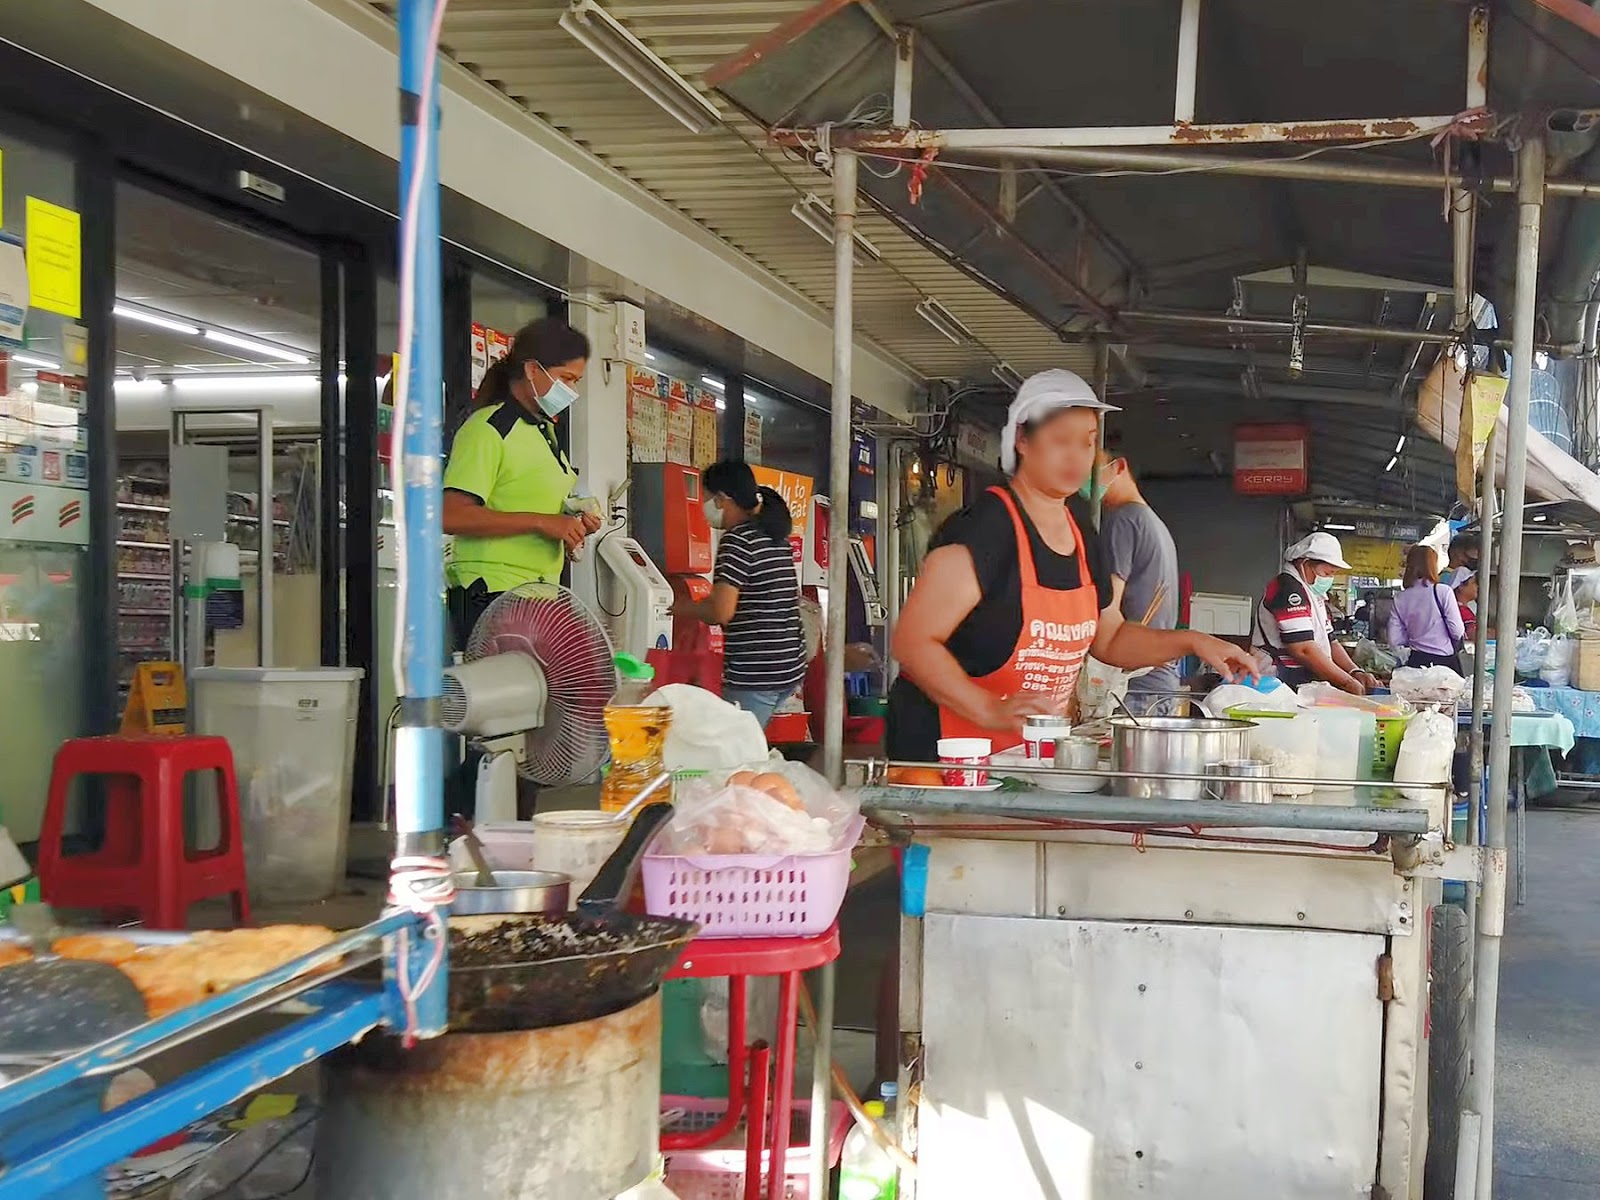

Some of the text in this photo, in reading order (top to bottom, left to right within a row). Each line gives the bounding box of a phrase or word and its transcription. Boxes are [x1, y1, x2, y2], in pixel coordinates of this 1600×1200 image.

[1243, 475, 1293, 484] KERRY
[794, 478, 806, 499] to
[789, 498, 807, 519] Eat
[1392, 526, 1417, 536] Open
